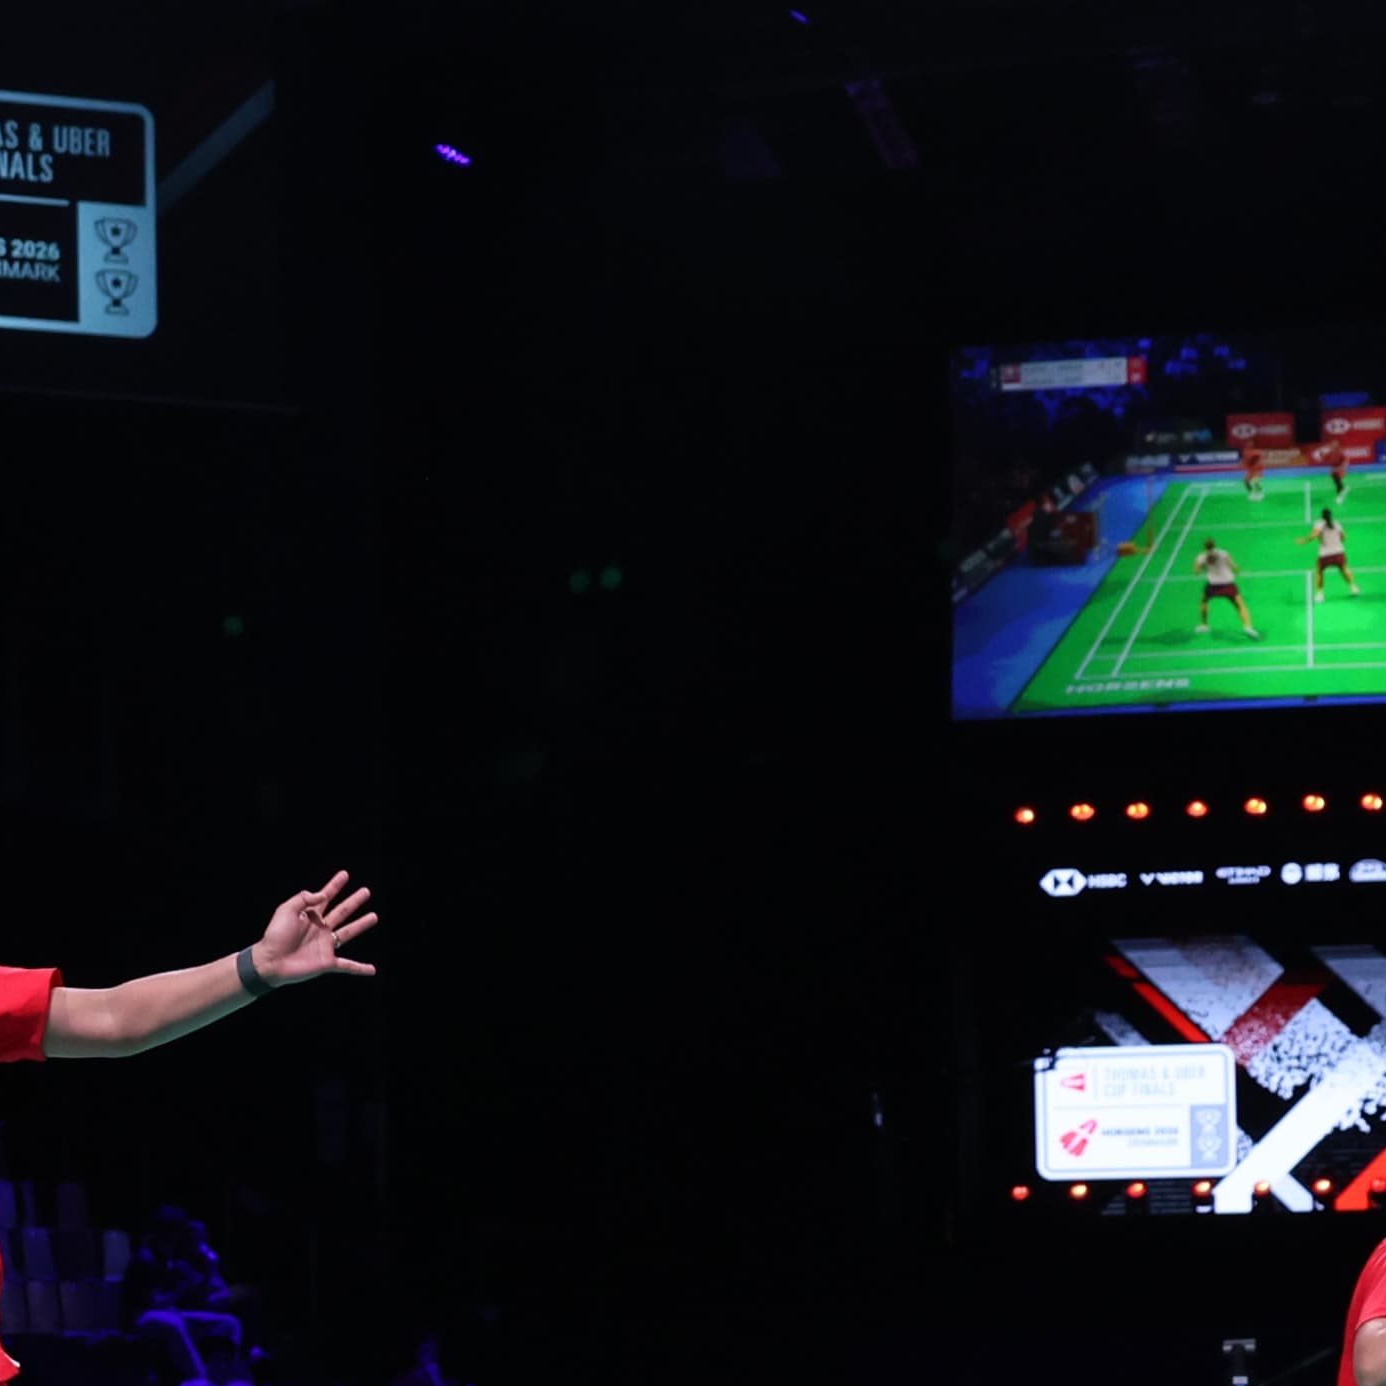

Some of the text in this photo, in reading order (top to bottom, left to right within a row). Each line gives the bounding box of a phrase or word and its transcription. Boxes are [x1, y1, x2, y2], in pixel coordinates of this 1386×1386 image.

[29, 124, 43, 152] &
[53, 126, 111, 157] UBER
[11, 238, 61, 261] 2026
